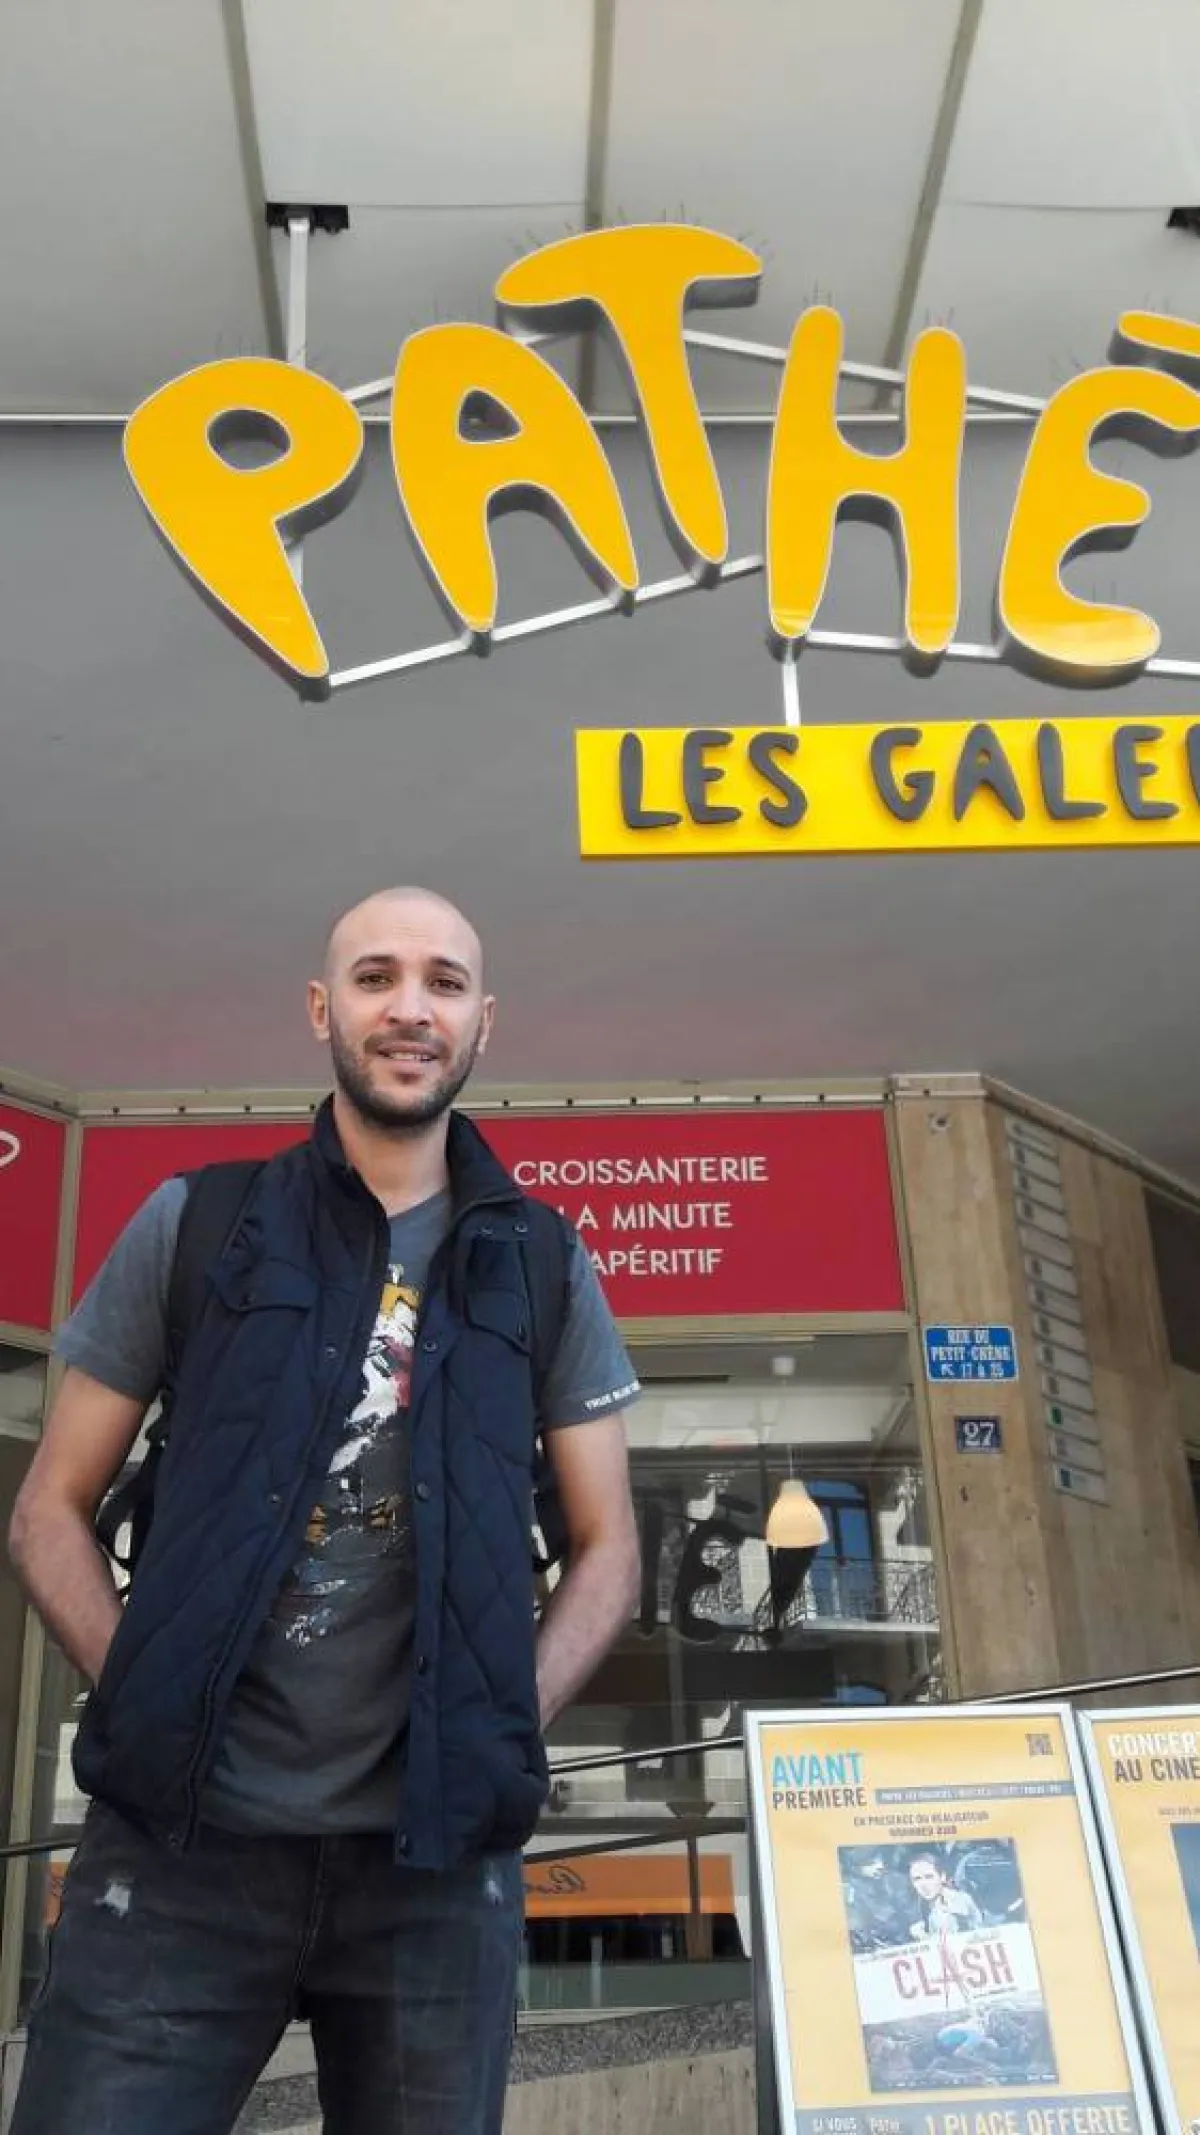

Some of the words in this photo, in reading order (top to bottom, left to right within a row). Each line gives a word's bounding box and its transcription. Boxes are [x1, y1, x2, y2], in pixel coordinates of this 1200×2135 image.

[619, 729, 808, 829] LES
[513, 1156, 770, 1187] CROISSANTERIE
[612, 1202, 733, 1231] MINUTE
[590, 1244, 725, 1276] APÉRITIF
[947, 1330, 971, 1343] RUE
[962, 1421, 995, 1447] 27
[1107, 1732, 1200, 1758] CONCER
[772, 1752, 863, 1787] AVANT
[1114, 1758, 1143, 1783] AU
[772, 1788, 867, 1810] PREMIERE
[892, 1942, 1015, 1999] CLASH
[1026, 2105, 1132, 2135] OFFERTE
